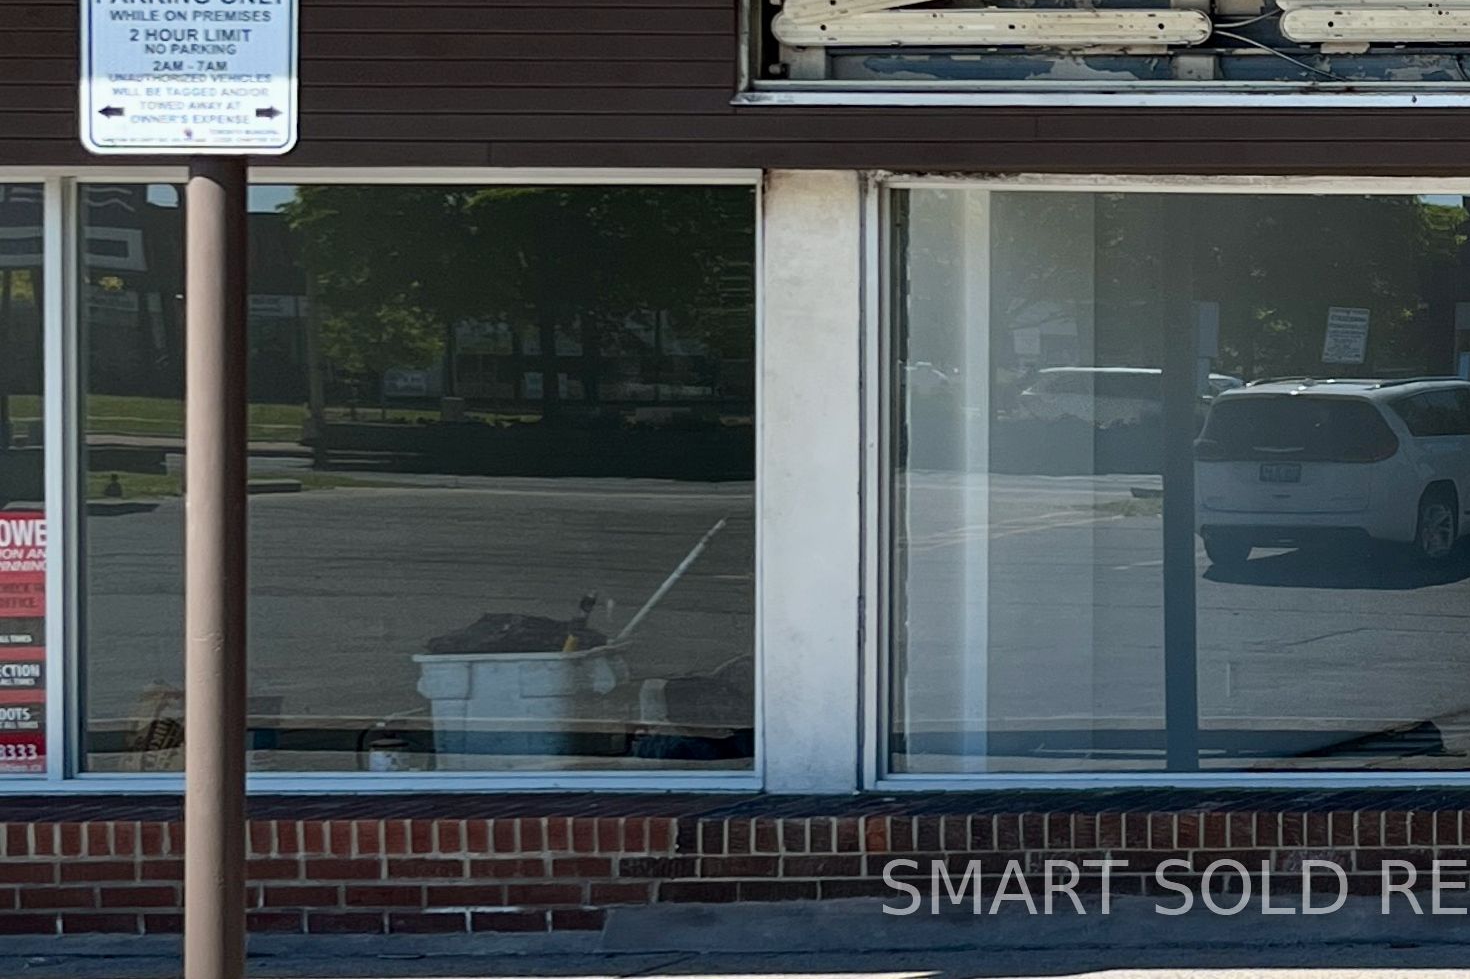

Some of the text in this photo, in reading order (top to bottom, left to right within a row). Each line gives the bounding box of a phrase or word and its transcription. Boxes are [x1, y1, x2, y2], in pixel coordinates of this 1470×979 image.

[110, 10, 272, 22] WHILE ON PREMISES
[129, 29, 252, 42] 2 HOUR LIMIT
[144, 44, 237, 55] NO PARKING
[153, 61, 183, 71] 2AM
[196, 61, 228, 71] 7AM
[109, 73, 272, 83] UNAUTHORIZED VEHICLES
[112, 87, 140, 97] WILL
[146, 87, 162, 97] BE
[167, 87, 217, 97] TAGGED
[140, 101, 241, 111] TOWED AWAY AT
[130, 115, 250, 125] OWNER'S EXPENSE
[0, 664, 40, 678] CTION
